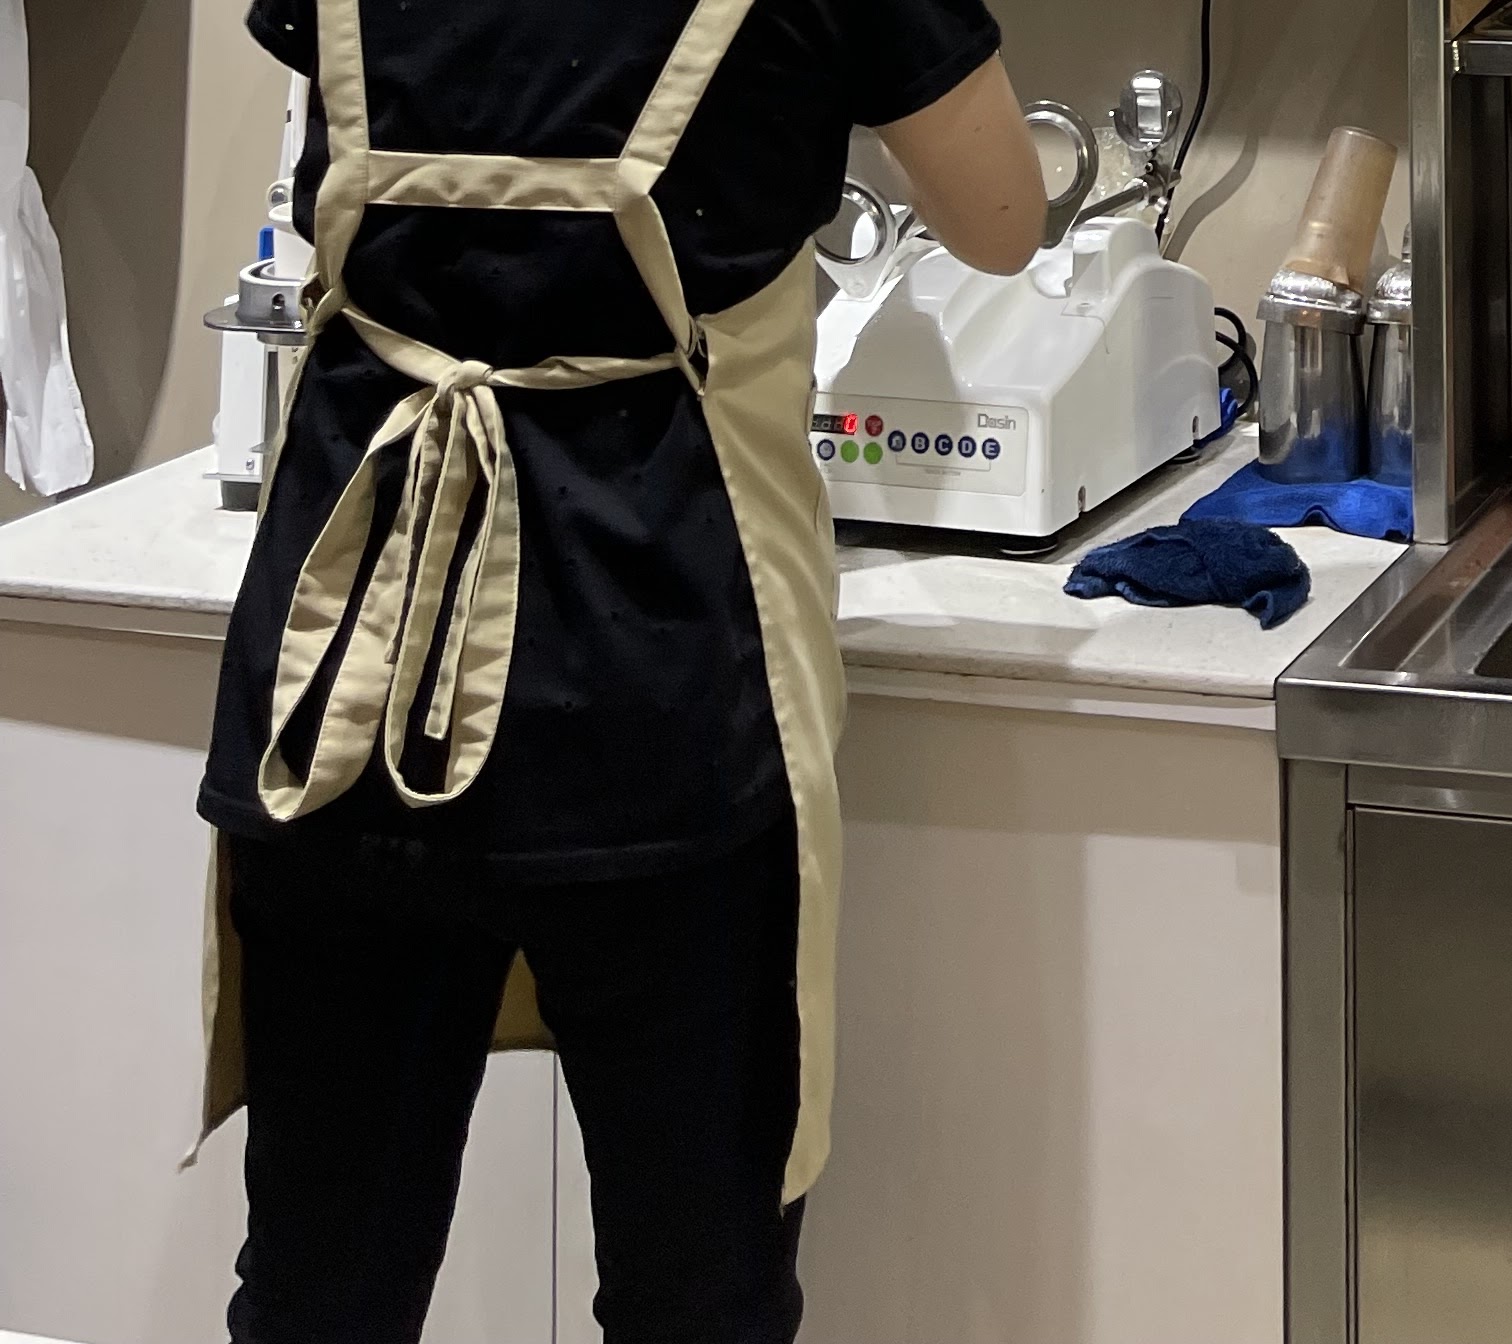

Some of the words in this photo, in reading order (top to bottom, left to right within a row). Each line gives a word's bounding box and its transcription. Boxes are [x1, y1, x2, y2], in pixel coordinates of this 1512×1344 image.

[977, 413, 1017, 431] Dasin
[916, 437, 926, 450] B
[939, 438, 950, 452] C
[962, 440, 974, 454] D
[984, 442, 997, 456] E
